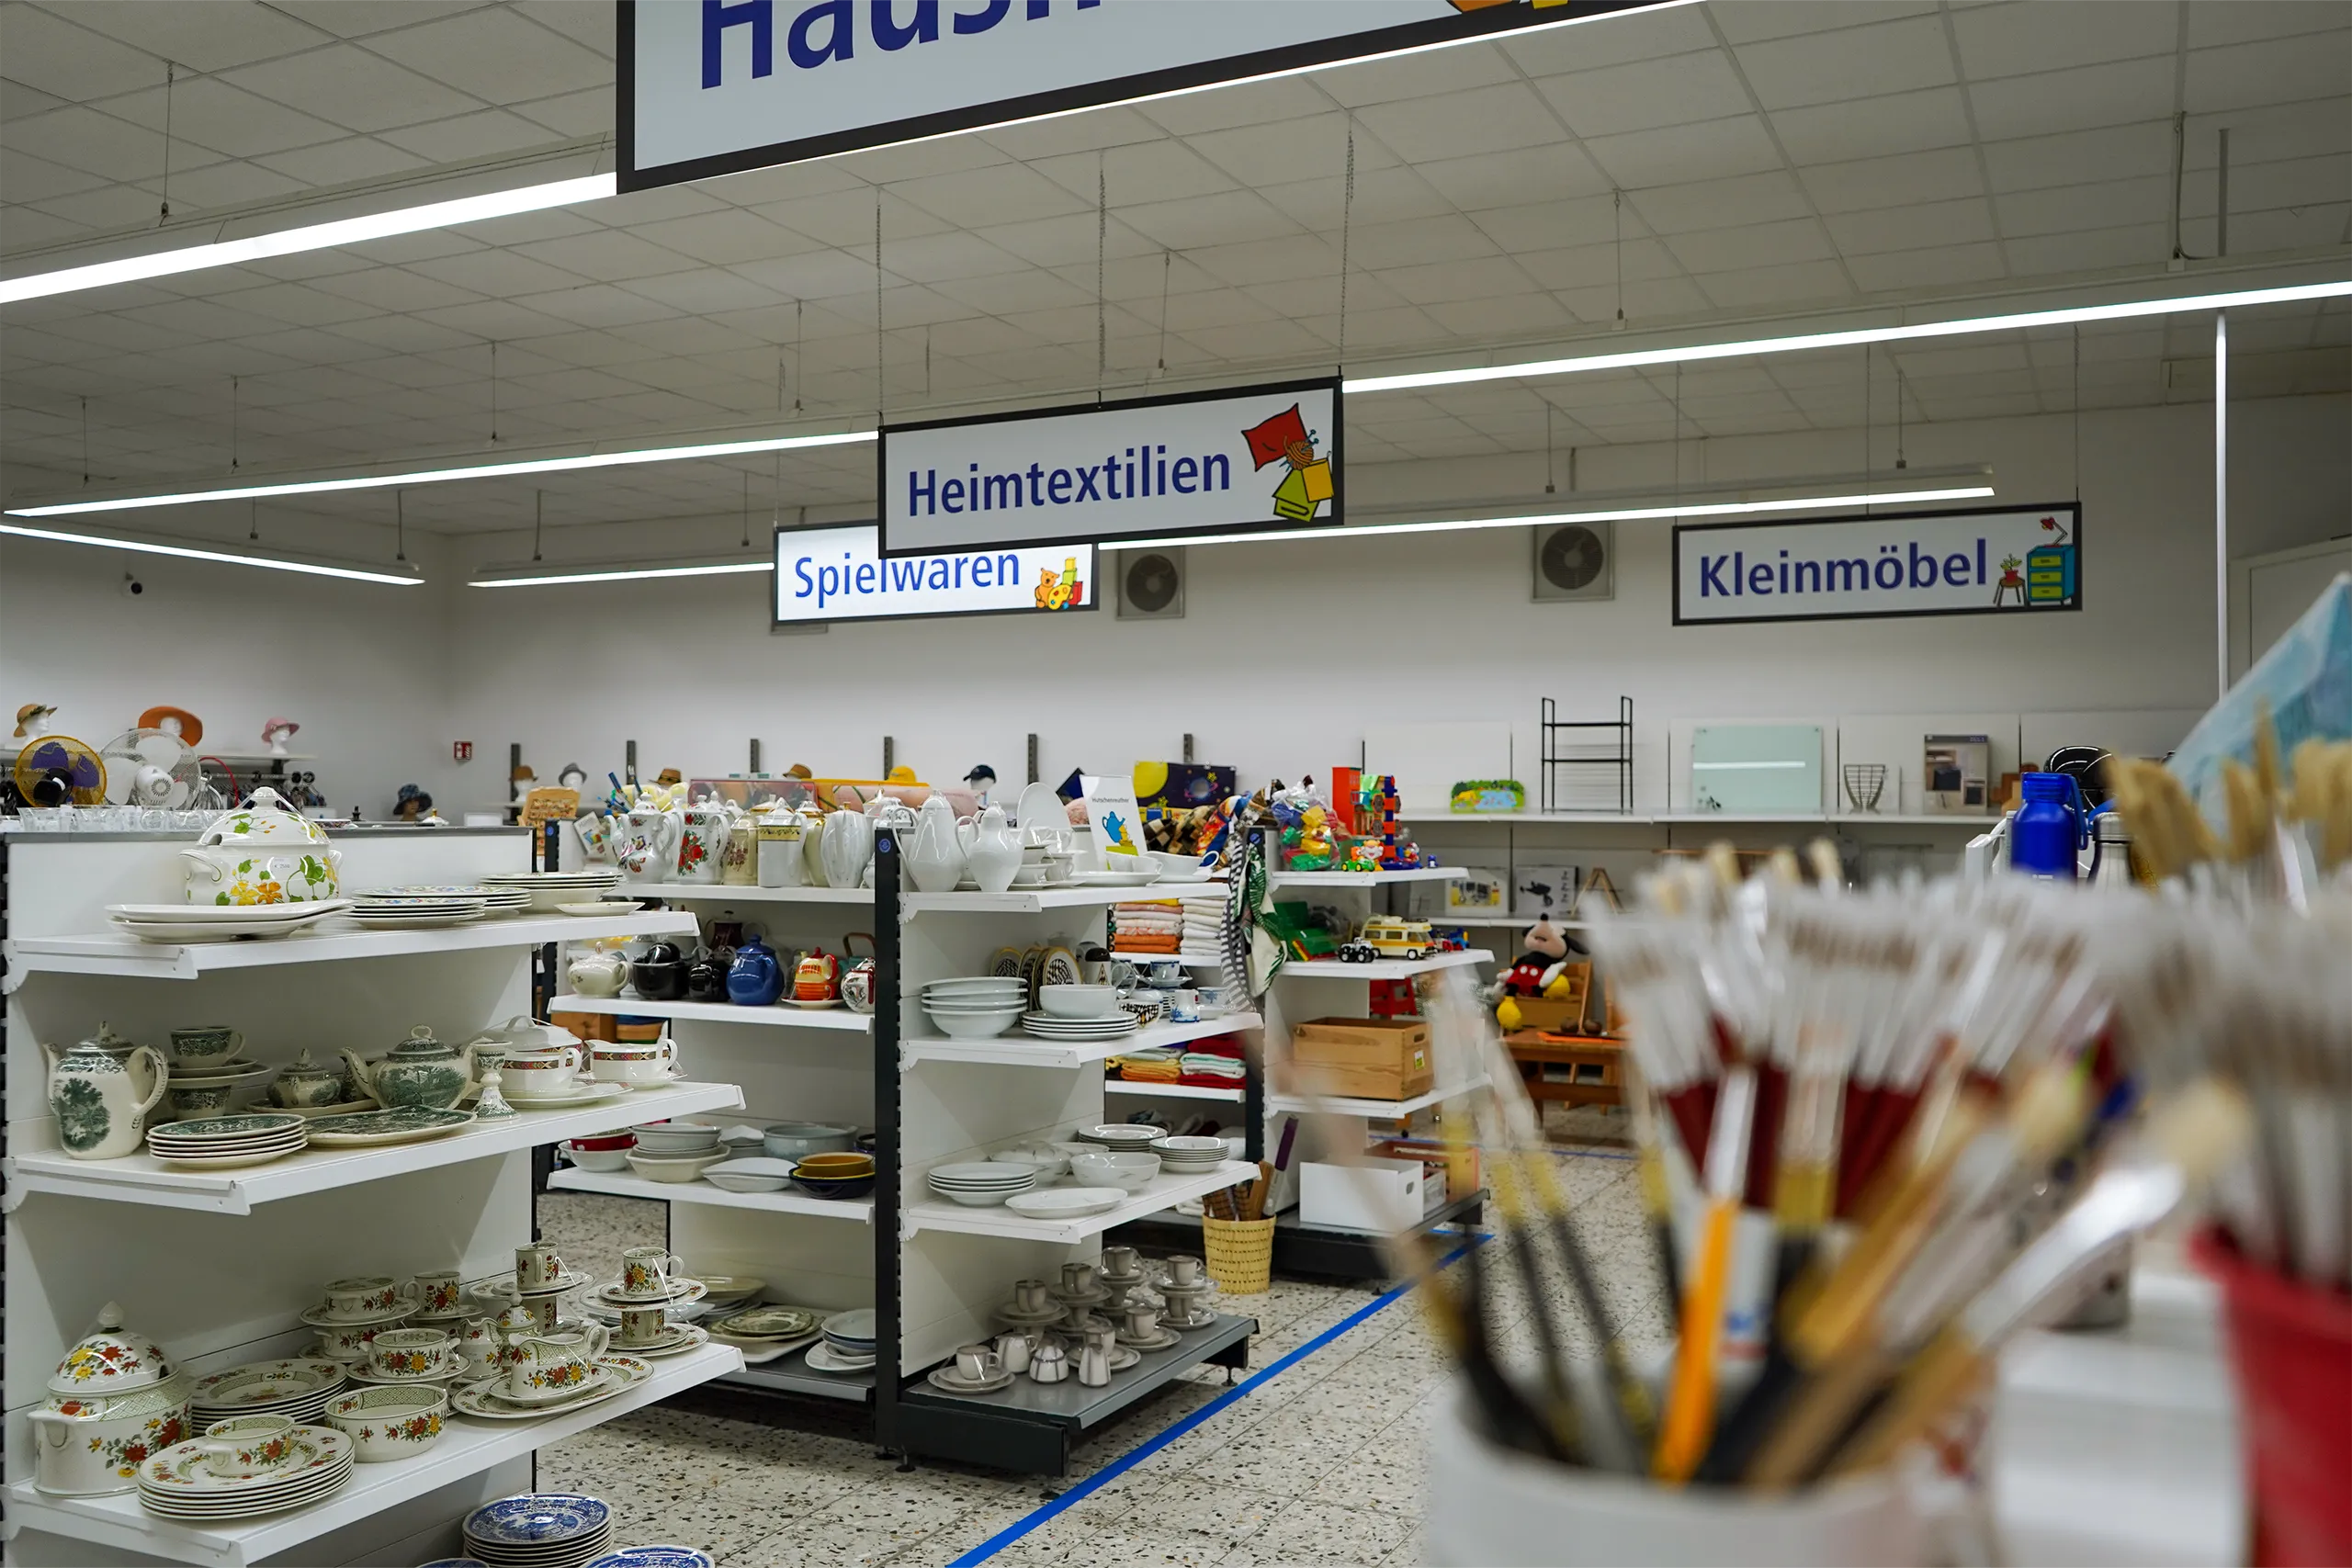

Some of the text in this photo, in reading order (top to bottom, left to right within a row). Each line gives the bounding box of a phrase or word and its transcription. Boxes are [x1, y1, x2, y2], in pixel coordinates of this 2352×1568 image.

[701, 0, 1101, 89] Hau
[909, 445, 1231, 517] Heimtextilien
[795, 552, 1021, 609] Spielwaren
[1701, 538, 1986, 597] Kleinmöbel
